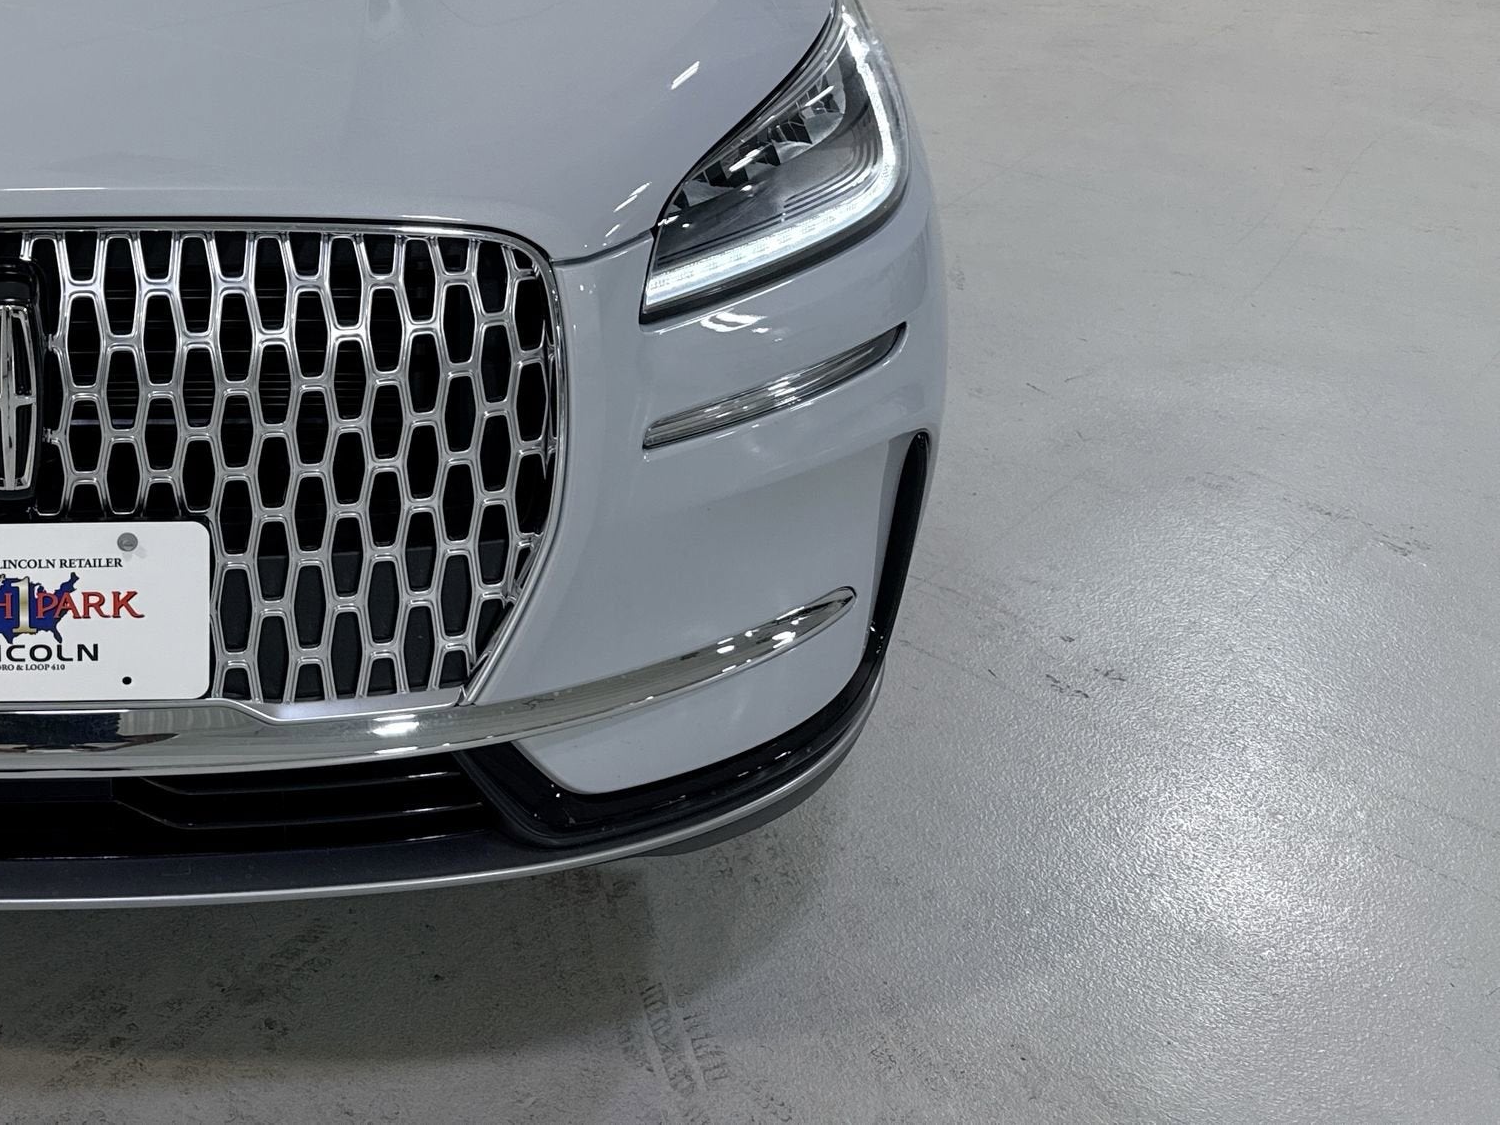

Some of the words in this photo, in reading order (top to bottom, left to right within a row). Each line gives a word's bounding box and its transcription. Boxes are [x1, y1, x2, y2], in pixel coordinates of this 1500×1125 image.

[59, 557, 124, 569] RETAILER
[35, 590, 146, 621] PARK
[16, 663, 24, 671] &
[25, 663, 50, 671] LOOP
